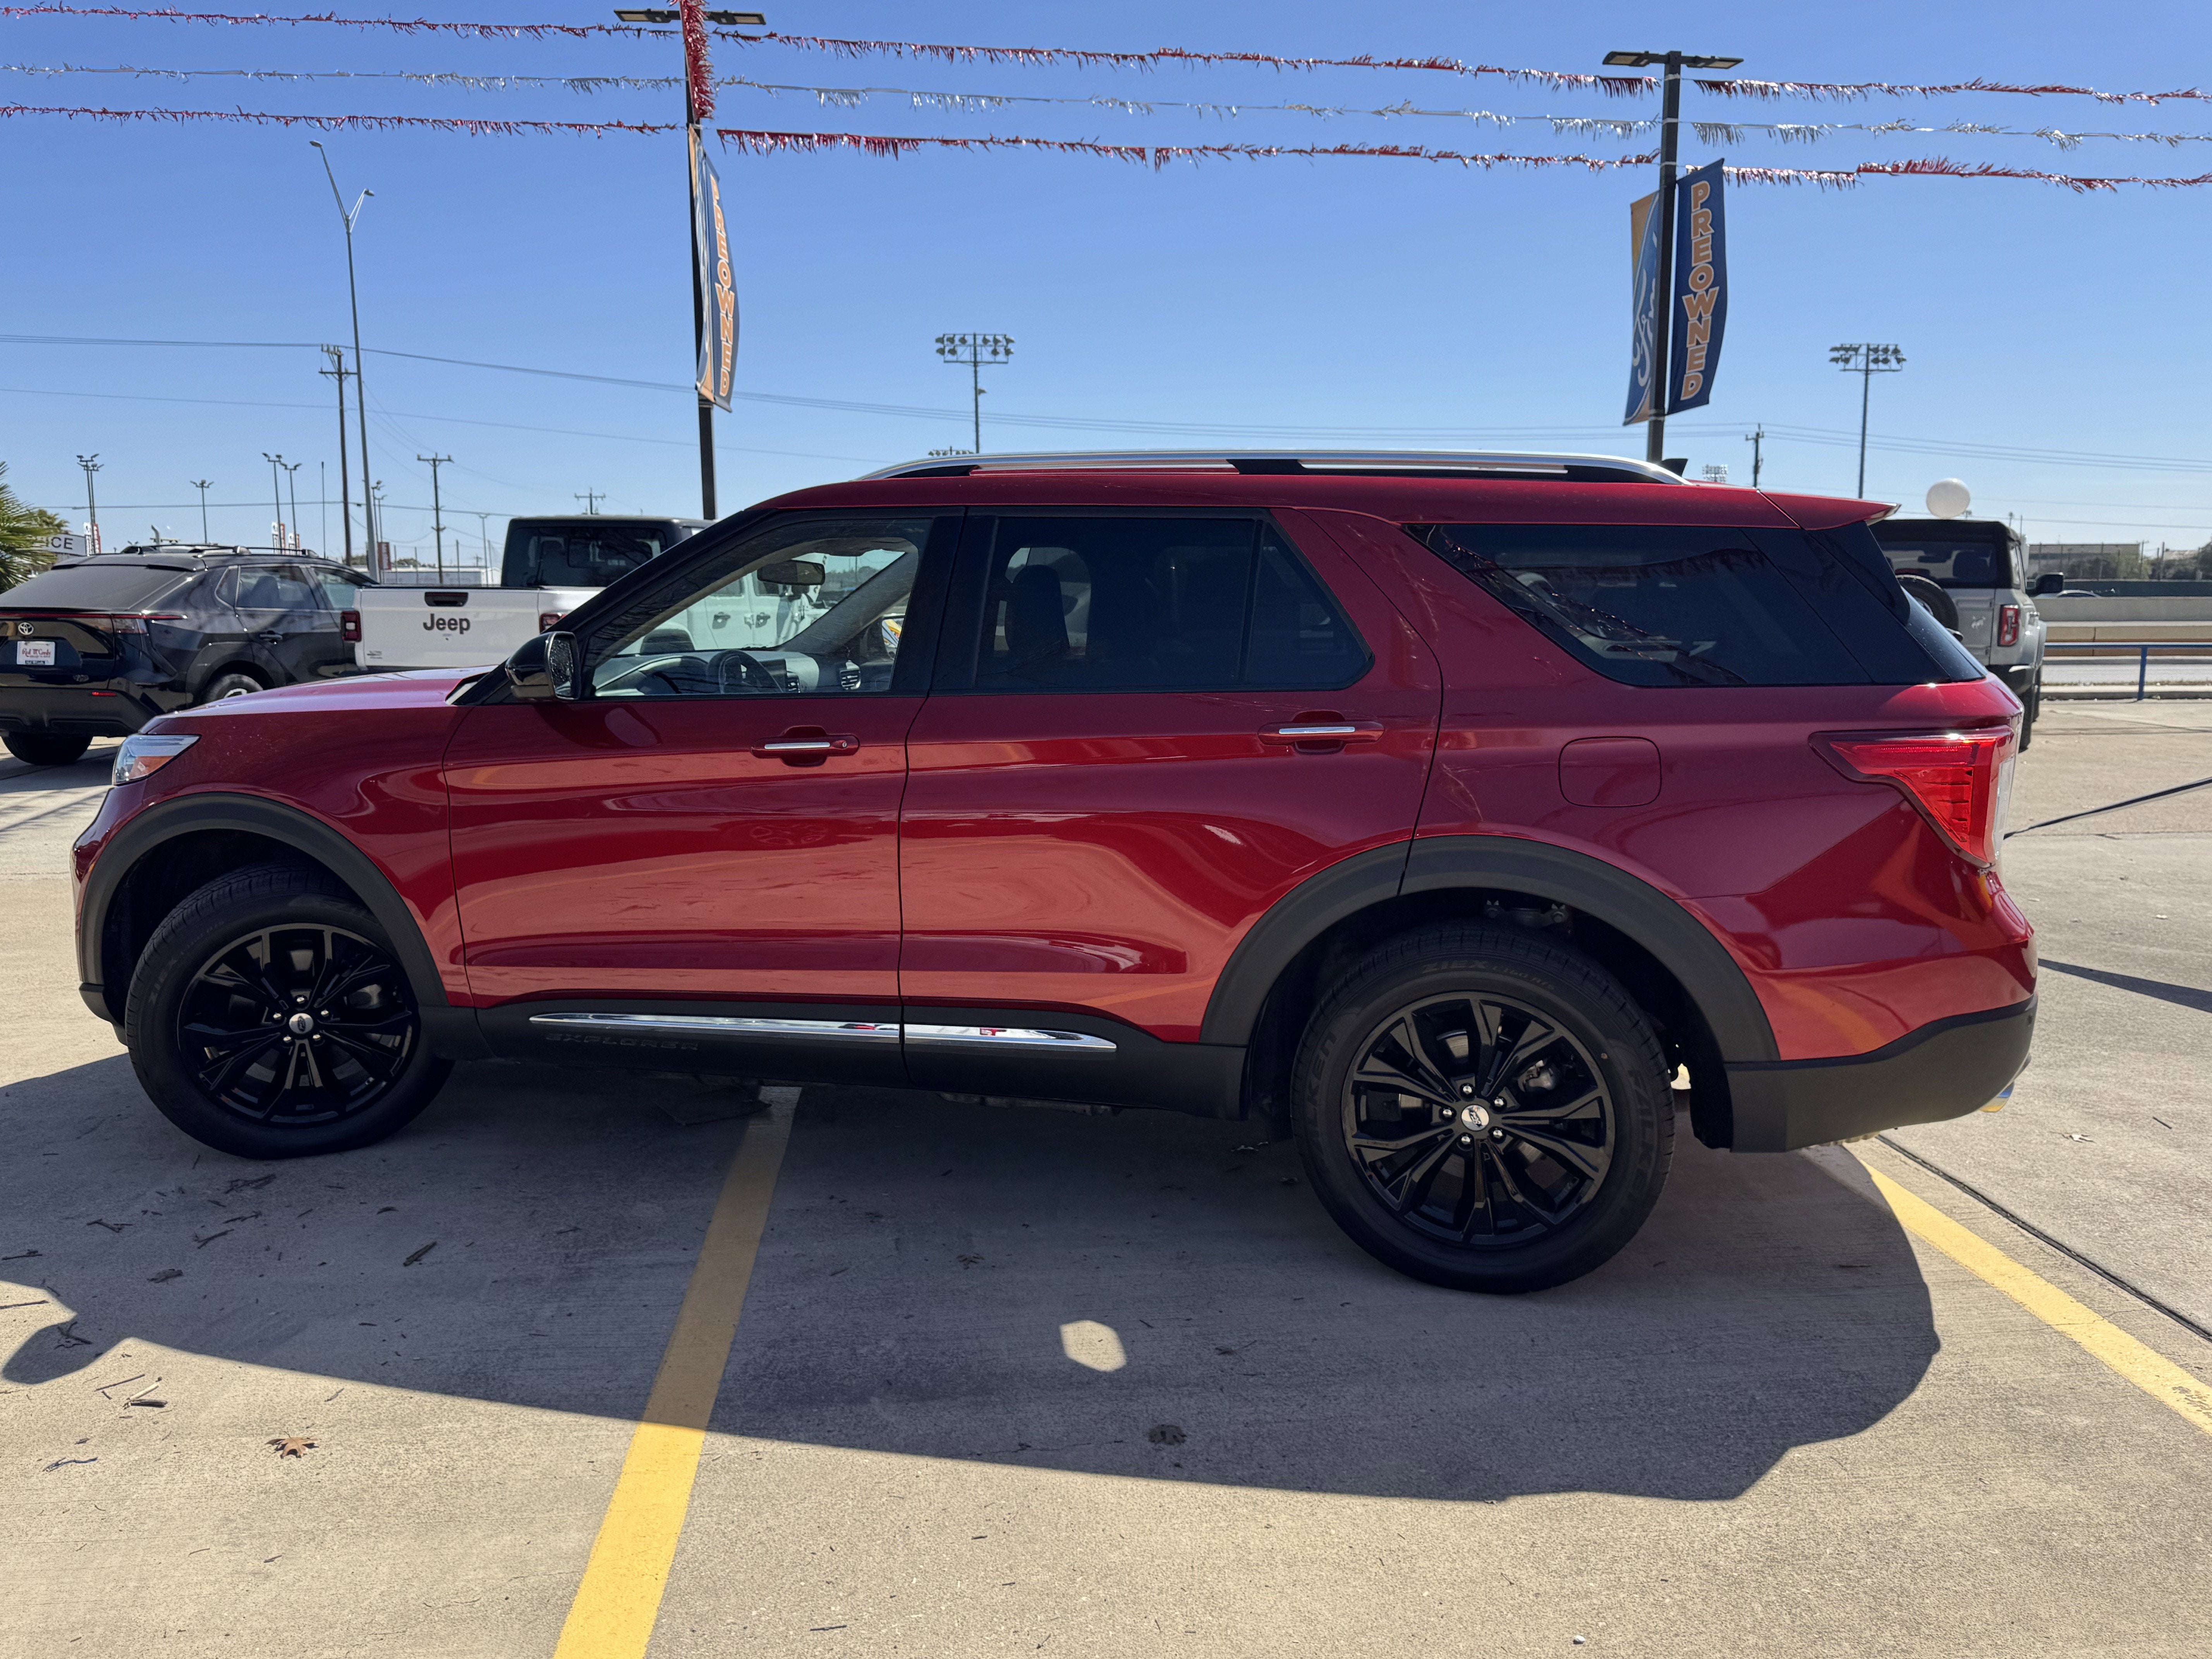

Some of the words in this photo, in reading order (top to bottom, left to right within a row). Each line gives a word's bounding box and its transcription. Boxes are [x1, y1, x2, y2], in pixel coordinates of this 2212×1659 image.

[1680, 180, 1719, 400] PREOWNED
[423, 613, 471, 635] Jeep
[546, 1032, 698, 1051] EXPLORER
